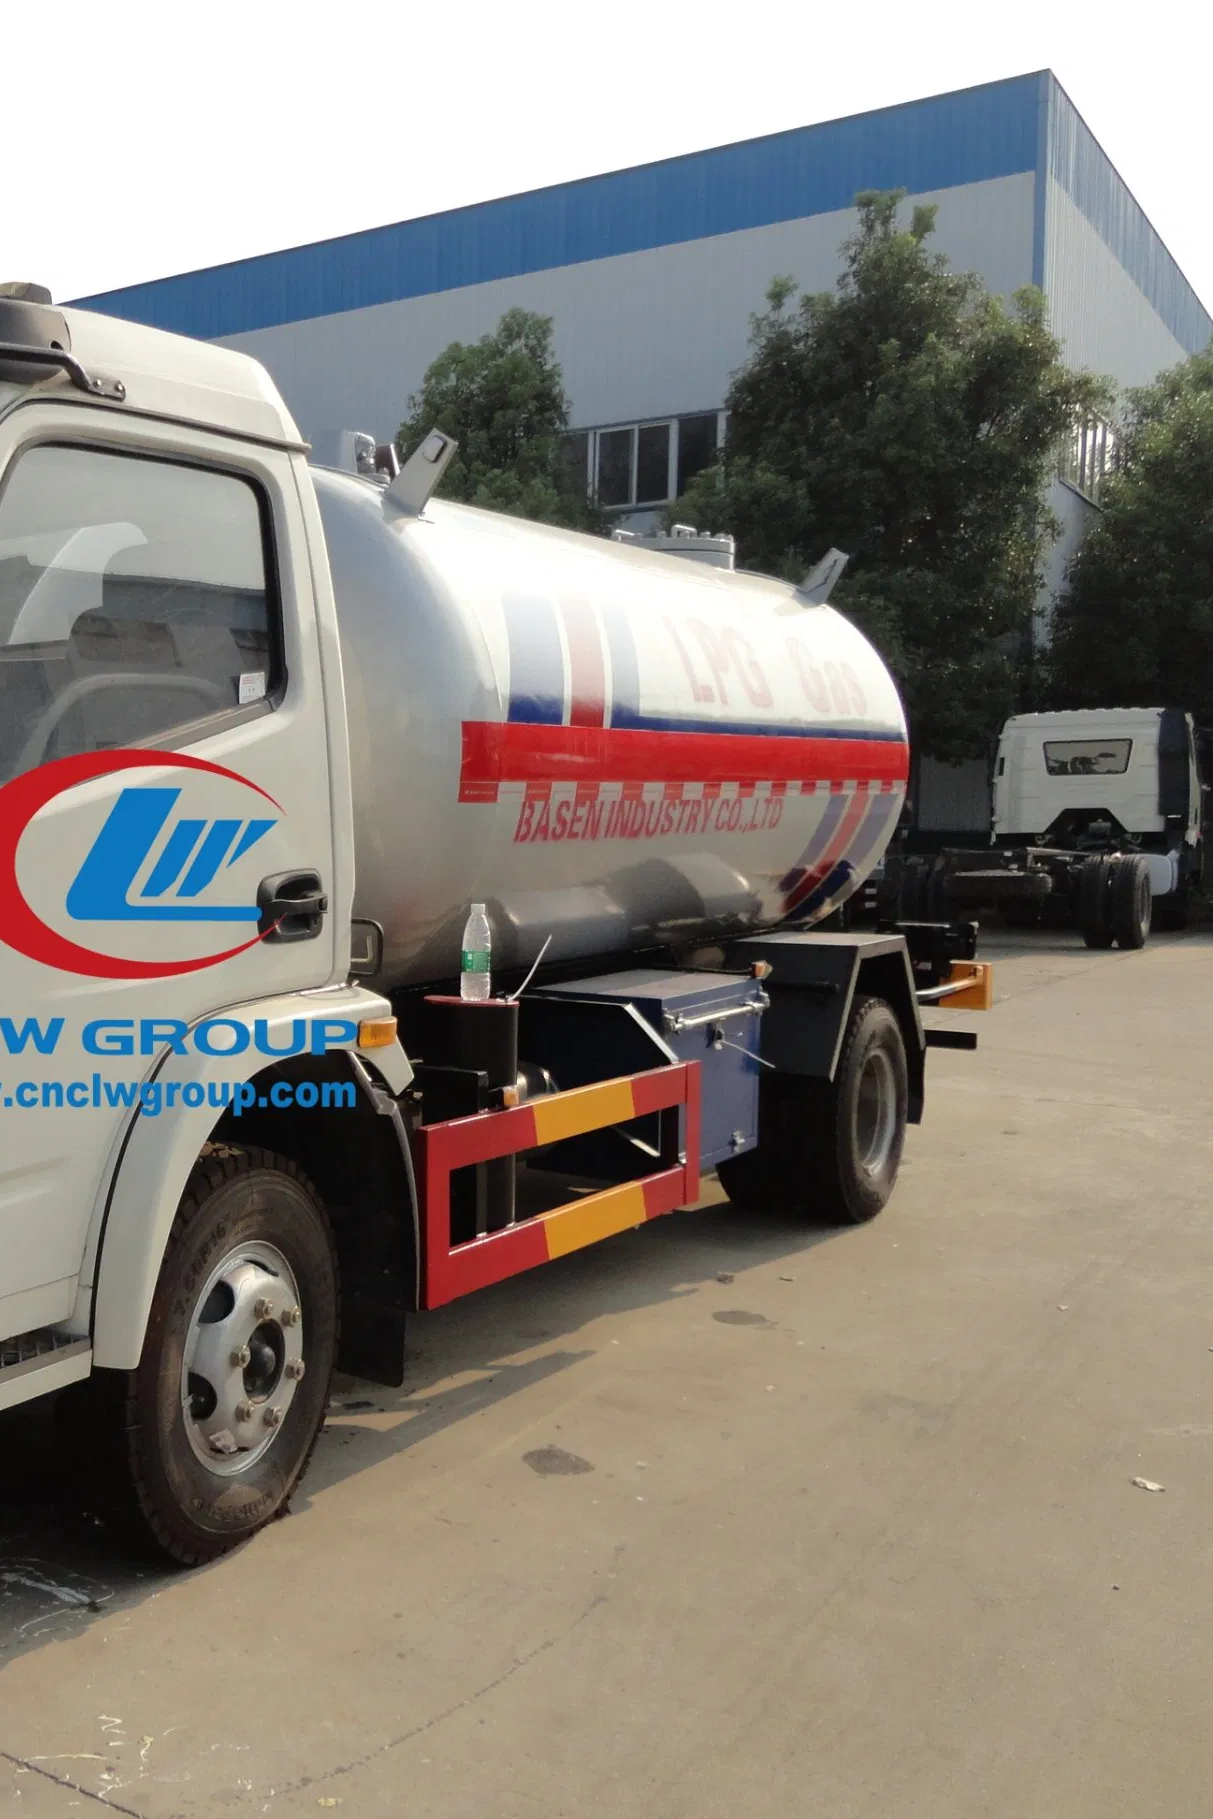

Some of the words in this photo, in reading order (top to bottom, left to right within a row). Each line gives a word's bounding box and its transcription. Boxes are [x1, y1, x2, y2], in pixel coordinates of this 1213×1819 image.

[662, 615, 774, 708] LPG
[786, 637, 868, 715] Gas
[513, 799, 605, 843] BASEN
[604, 798, 716, 840] INDUSTRY
